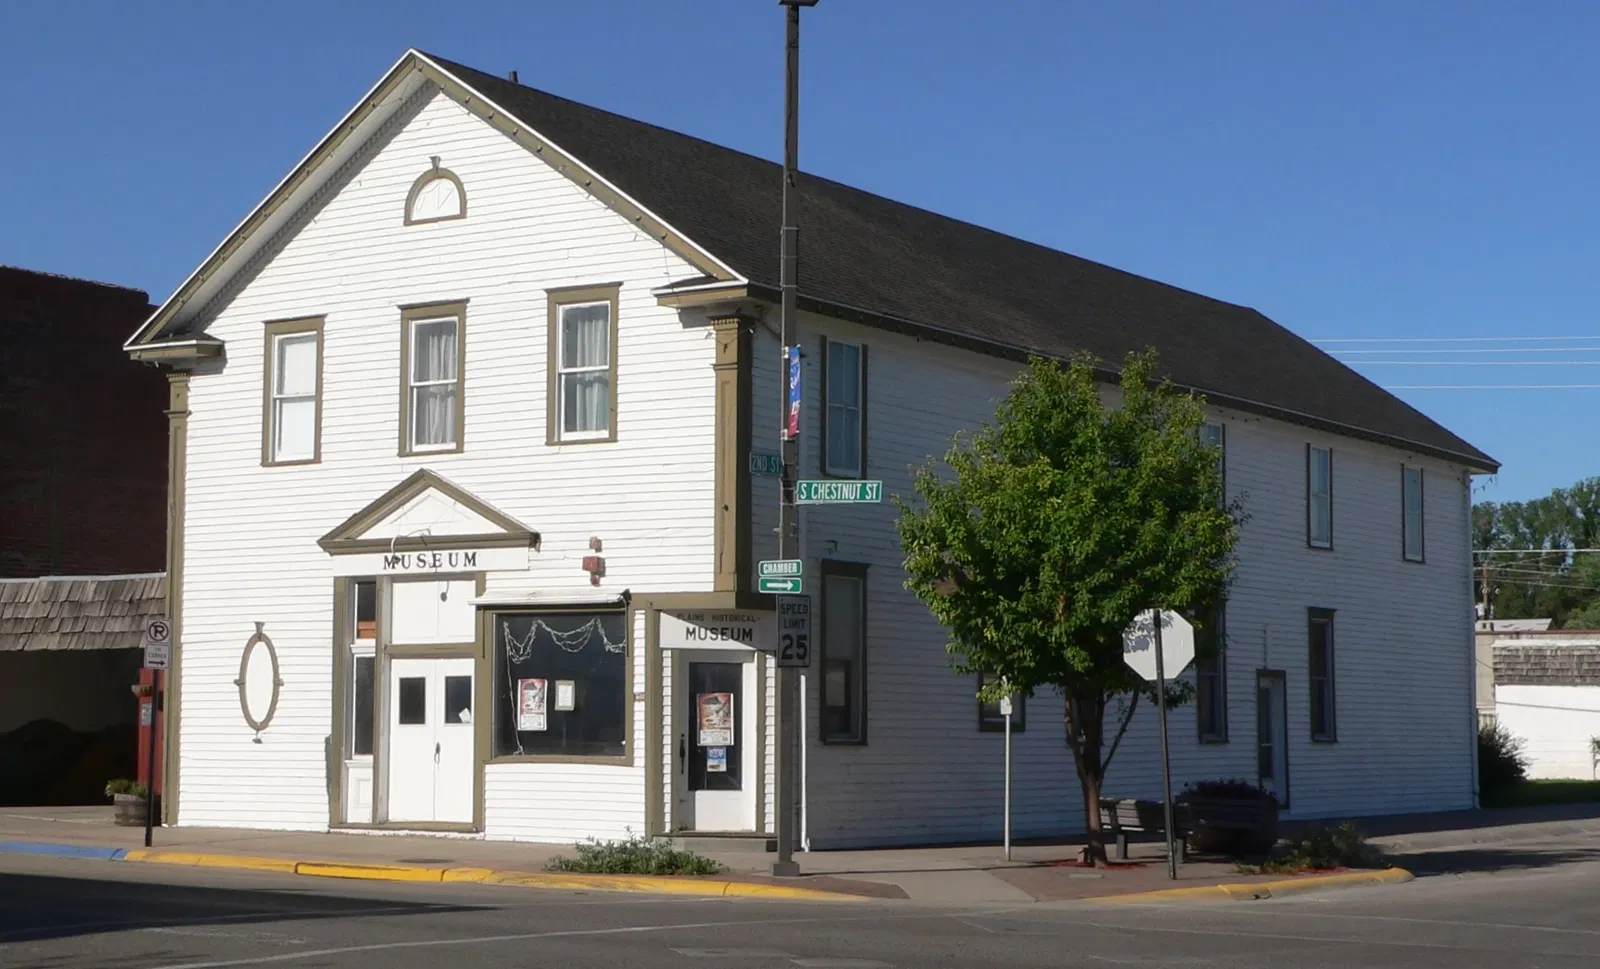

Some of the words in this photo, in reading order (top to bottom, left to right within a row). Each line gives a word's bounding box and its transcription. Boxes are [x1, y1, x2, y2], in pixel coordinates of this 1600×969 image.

[752, 455, 767, 471] 2ND
[770, 457, 780, 472] ST
[800, 484, 807, 499] S
[812, 484, 861, 499] CHESTNUT
[866, 484, 878, 499] ST
[383, 551, 477, 570] MUSEUM
[763, 563, 797, 573] CHAMBER
[780, 604, 808, 614] SPEED
[784, 619, 805, 629] LIMIT
[685, 627, 752, 641] MUSEUM
[781, 634, 807, 660] 25
